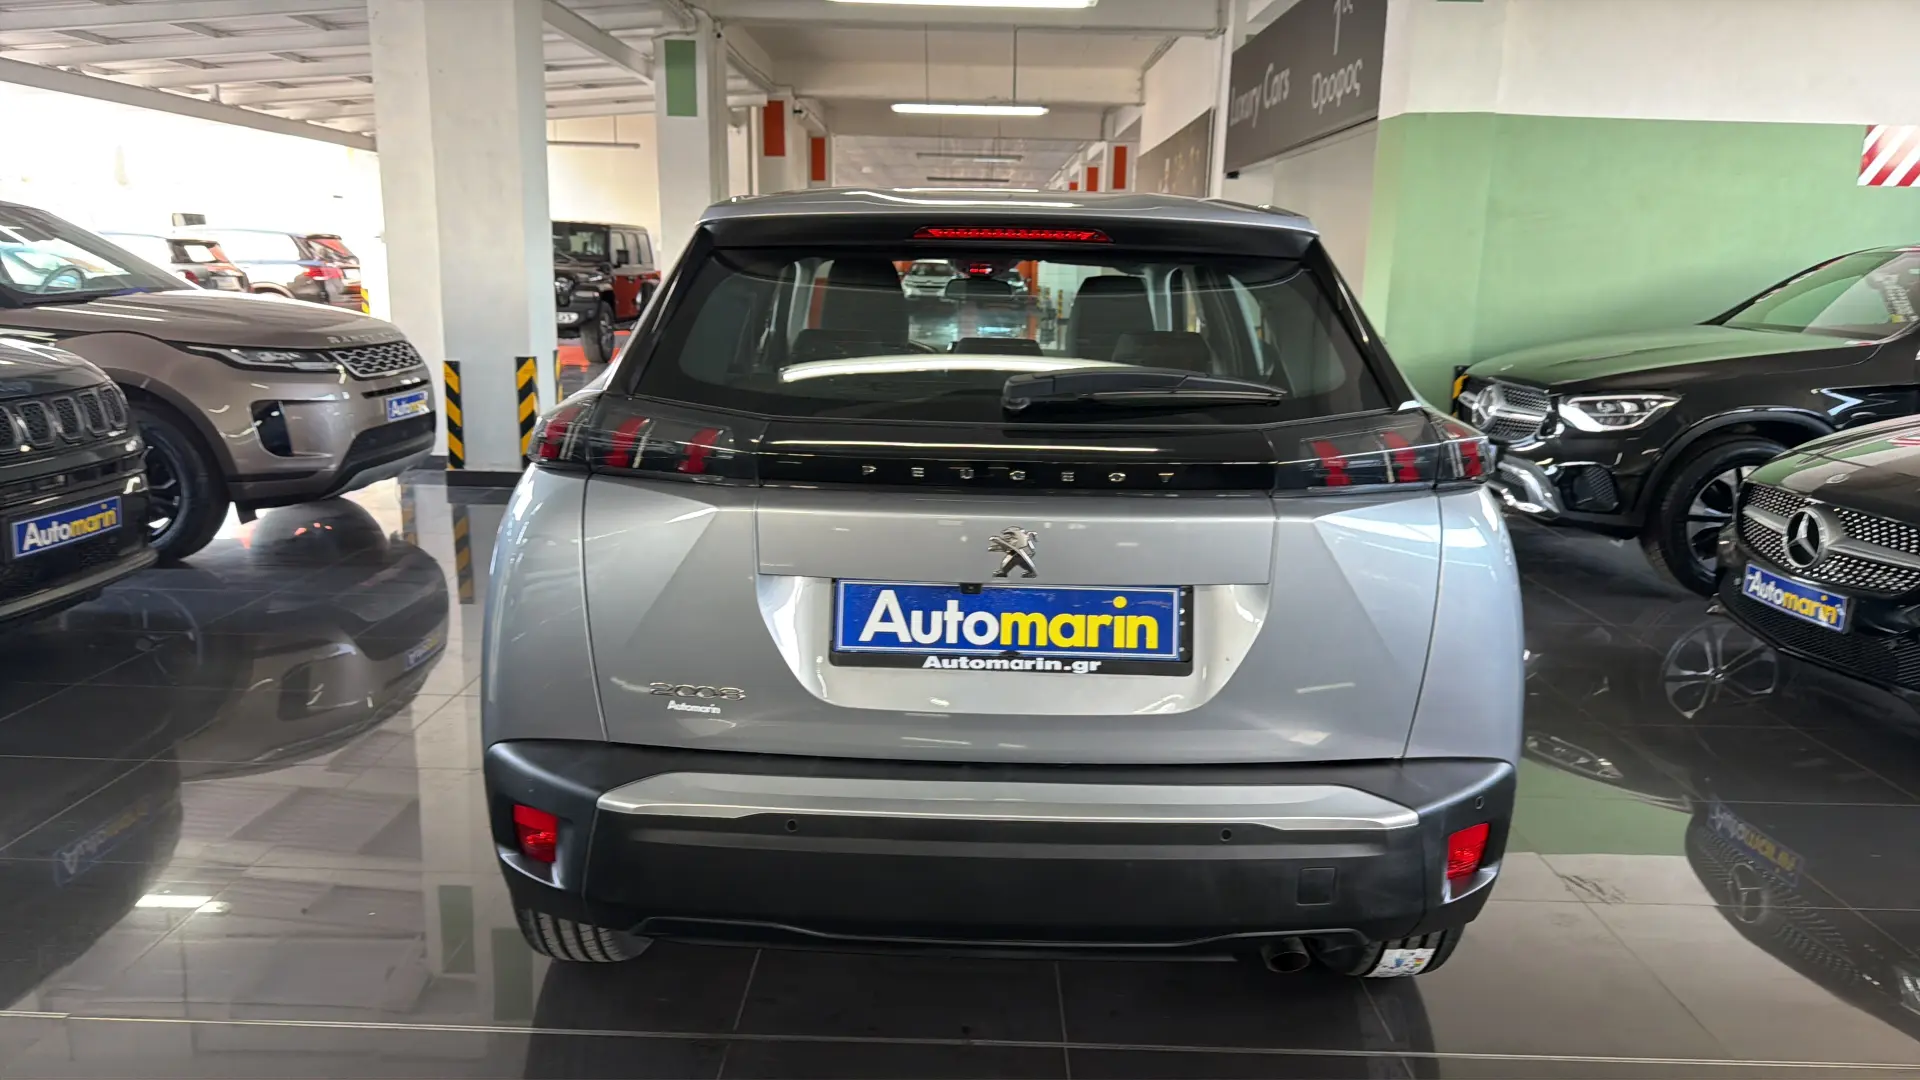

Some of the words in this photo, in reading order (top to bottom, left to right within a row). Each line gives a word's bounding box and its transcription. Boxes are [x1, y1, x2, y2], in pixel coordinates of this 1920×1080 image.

[1230, 83, 1262, 128] Luxury
[1263, 62, 1290, 109] Cars
[861, 464, 1175, 484] PEUGEOT
[22, 503, 117, 551] Automarin
[1748, 570, 1838, 625] Automarin
[858, 588, 1159, 650] Automarin
[922, 654, 1102, 675] Automarin.gr
[649, 682, 746, 701] 2008
[667, 700, 721, 714] Automarin
